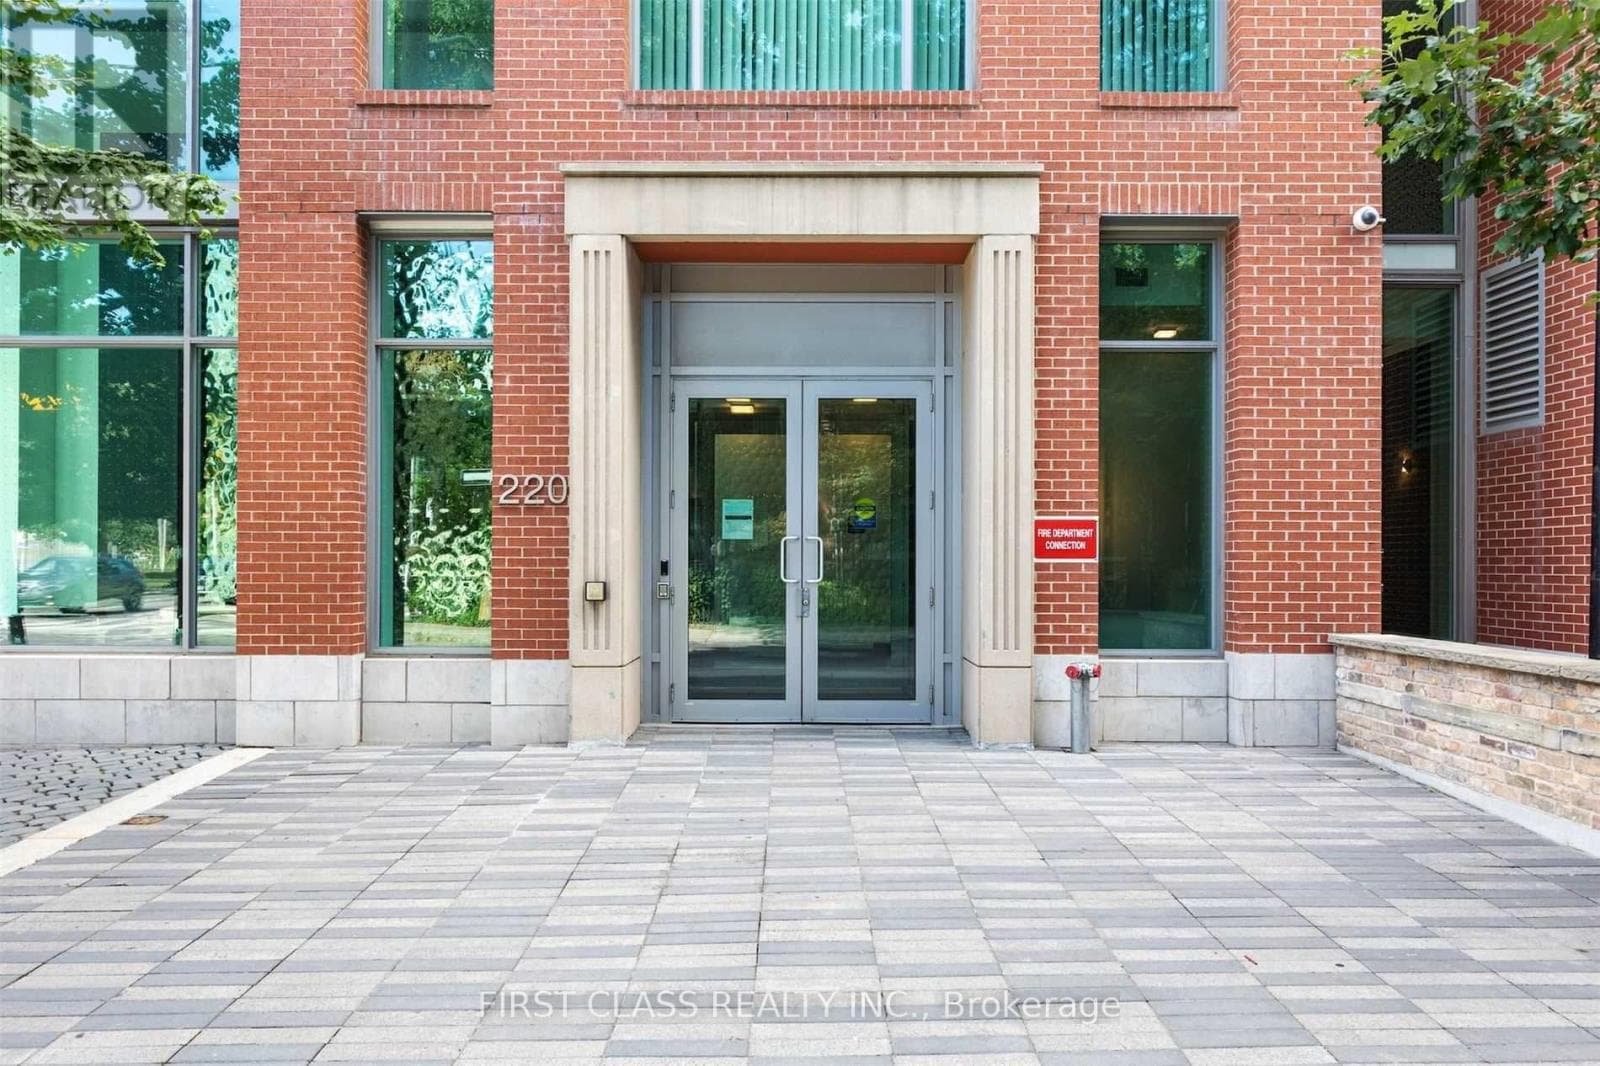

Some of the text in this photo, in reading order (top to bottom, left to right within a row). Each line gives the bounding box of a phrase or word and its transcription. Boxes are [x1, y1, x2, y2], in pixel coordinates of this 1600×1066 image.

[498, 473, 569, 506] 220
[1037, 528, 1094, 538] FIRE DEPARTMENT
[1045, 541, 1086, 550] CONNECTION
